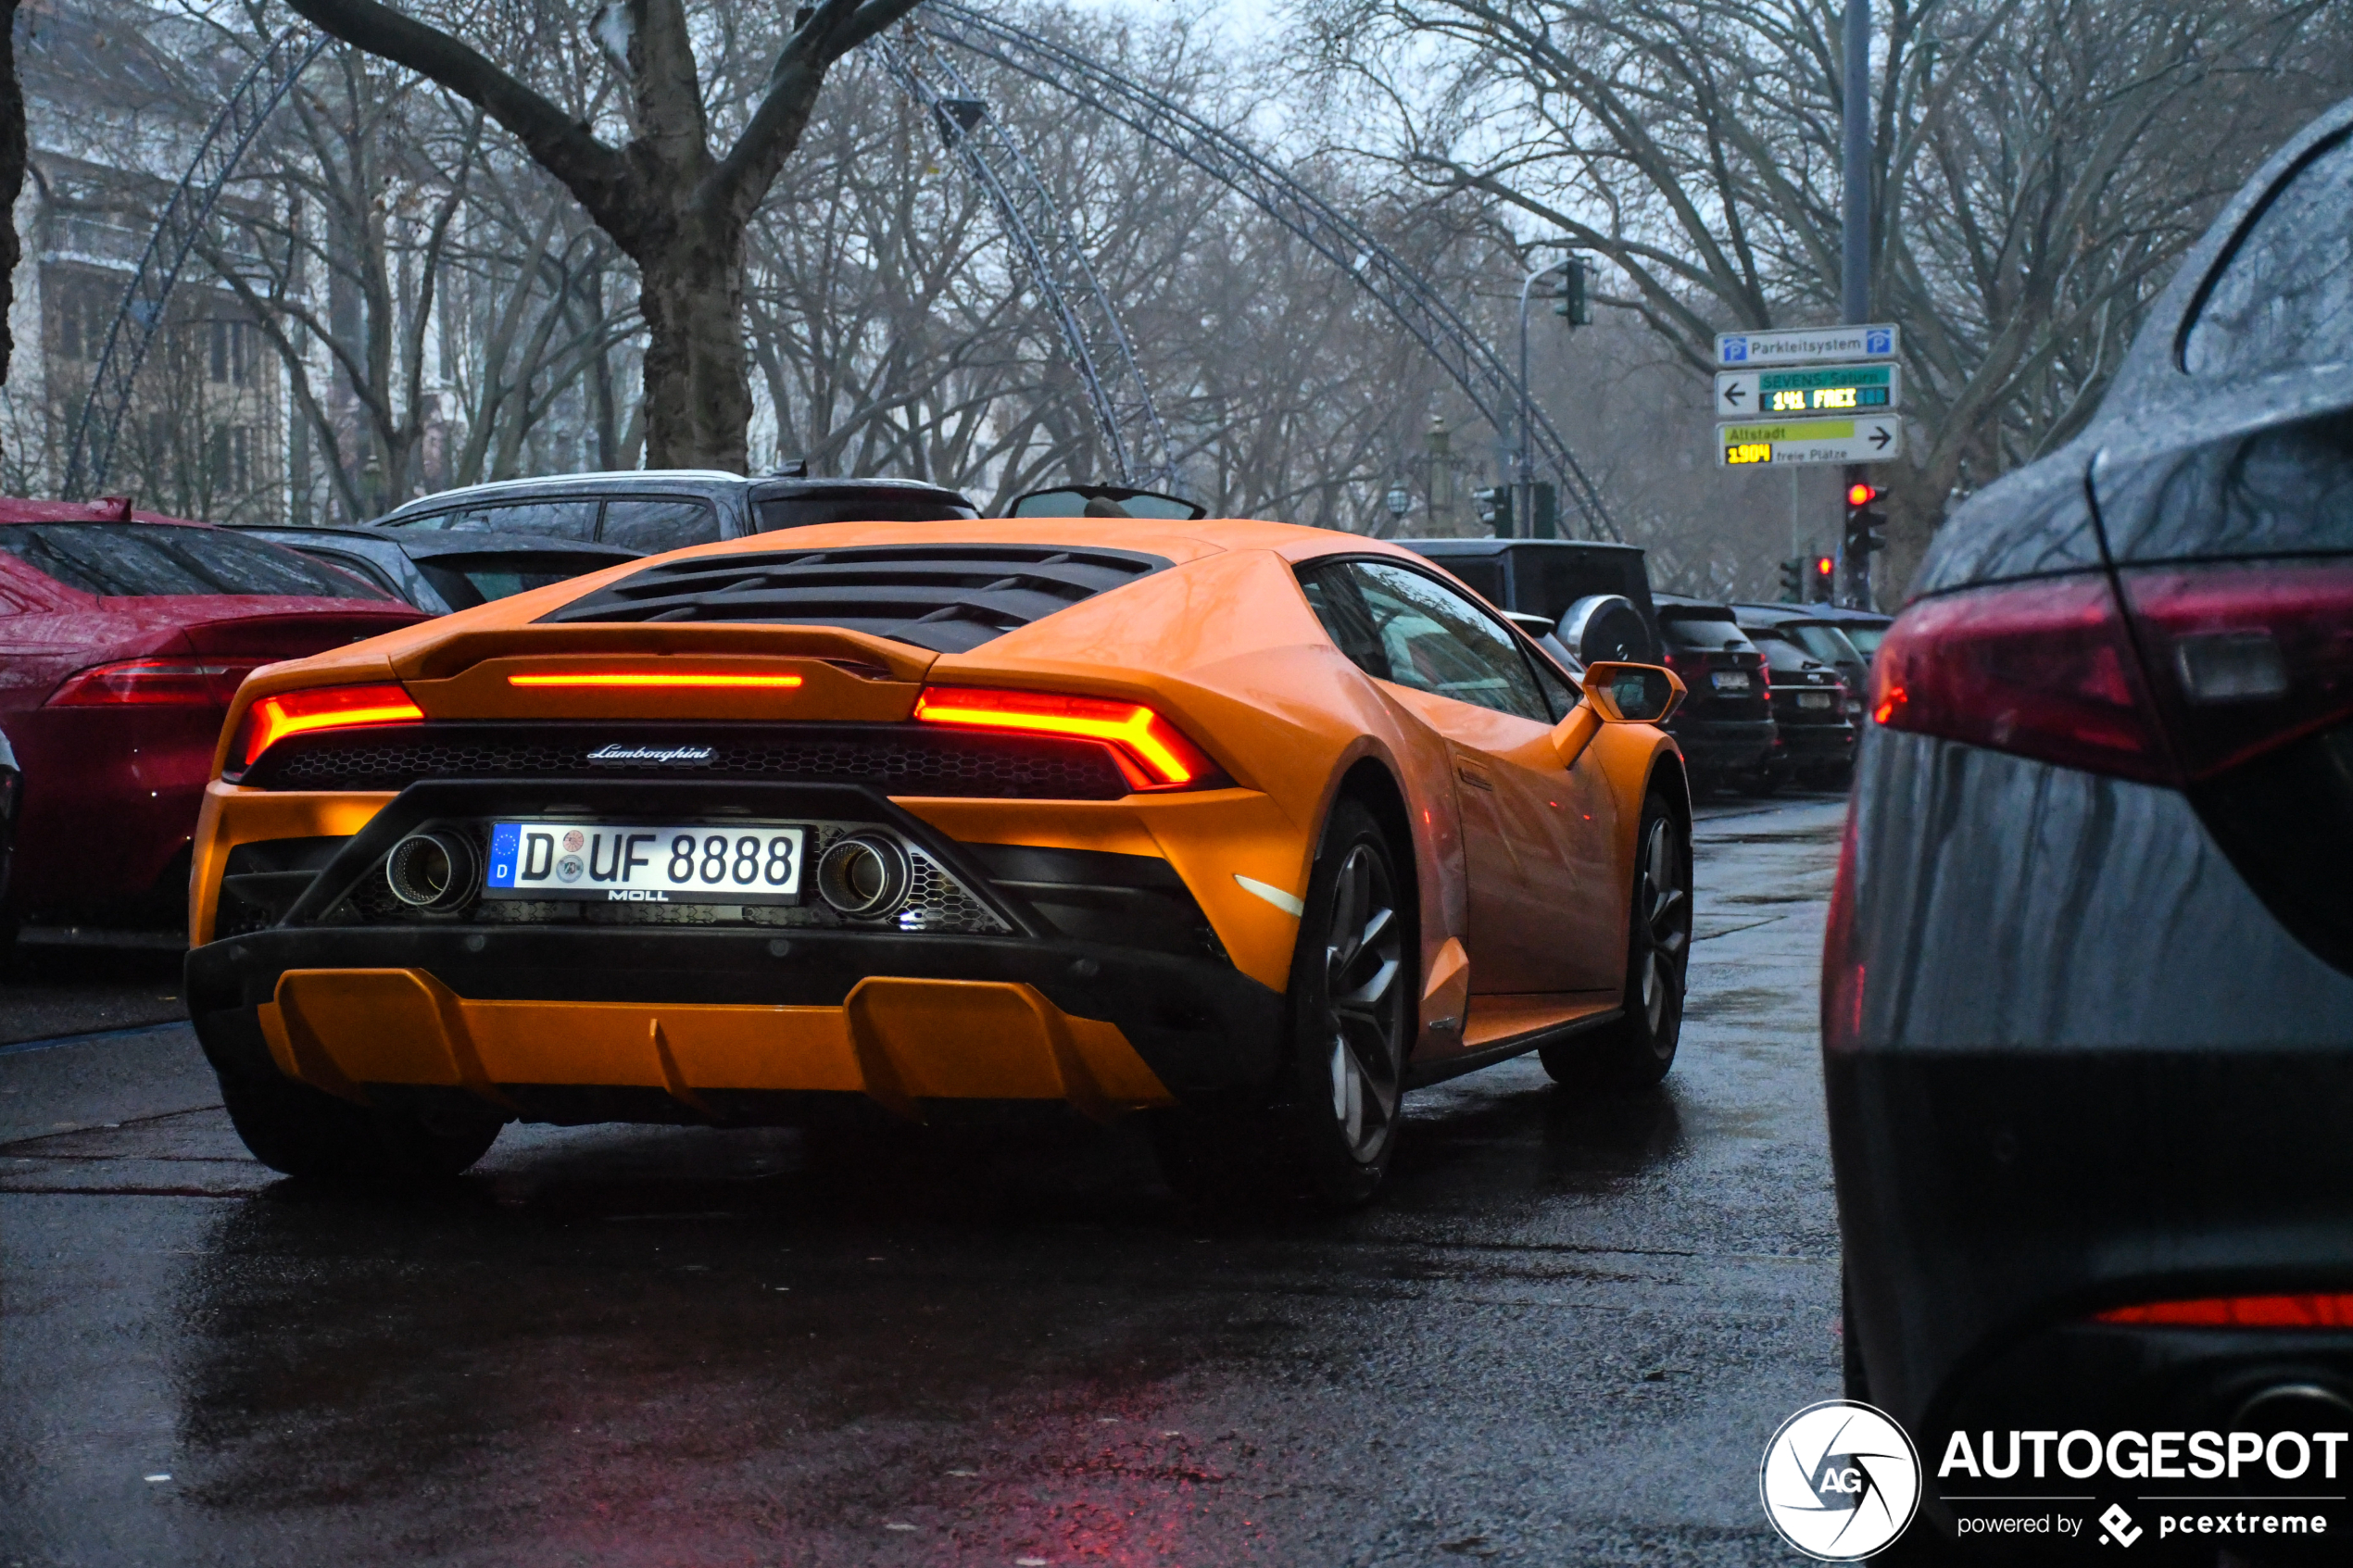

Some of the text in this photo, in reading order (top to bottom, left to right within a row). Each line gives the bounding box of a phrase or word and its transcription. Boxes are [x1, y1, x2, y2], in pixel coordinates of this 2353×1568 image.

[1752, 338, 1861, 355] Parkleitsystem
[1773, 388, 1856, 411] 141 FREI
[1730, 428, 1785, 441] Altstadt
[1728, 444, 1771, 464] 1904
[1777, 448, 1847, 461] freie Plätze
[586, 743, 712, 761] Lamborghini
[521, 833, 794, 885] D UF 8888
[497, 864, 508, 879] D
[608, 890, 669, 901] MOLL
